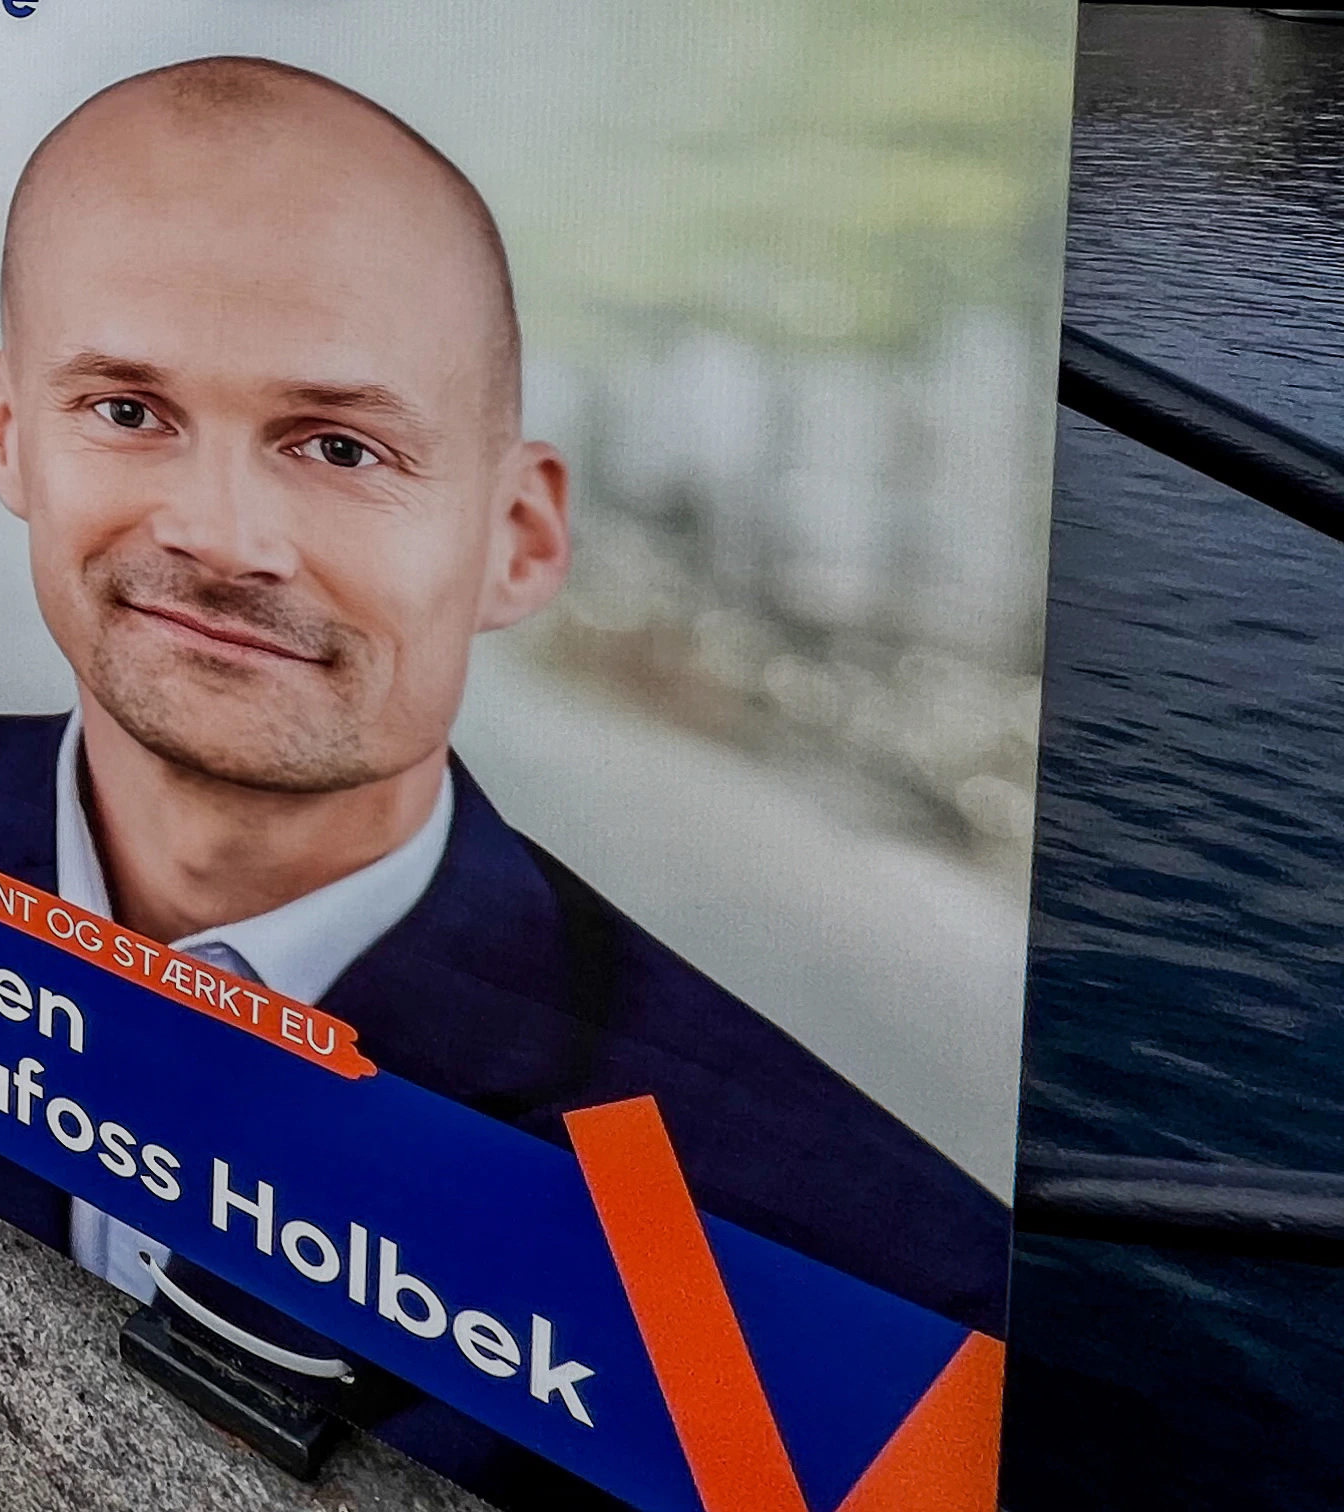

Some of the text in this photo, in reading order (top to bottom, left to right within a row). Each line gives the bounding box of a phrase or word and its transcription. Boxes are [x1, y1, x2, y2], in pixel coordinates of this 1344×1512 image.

[47, 905, 104, 952] OG
[113, 934, 270, 1026] STÆRKT
[281, 1005, 336, 1057] EU
[211, 1161, 595, 1428] Holbek
